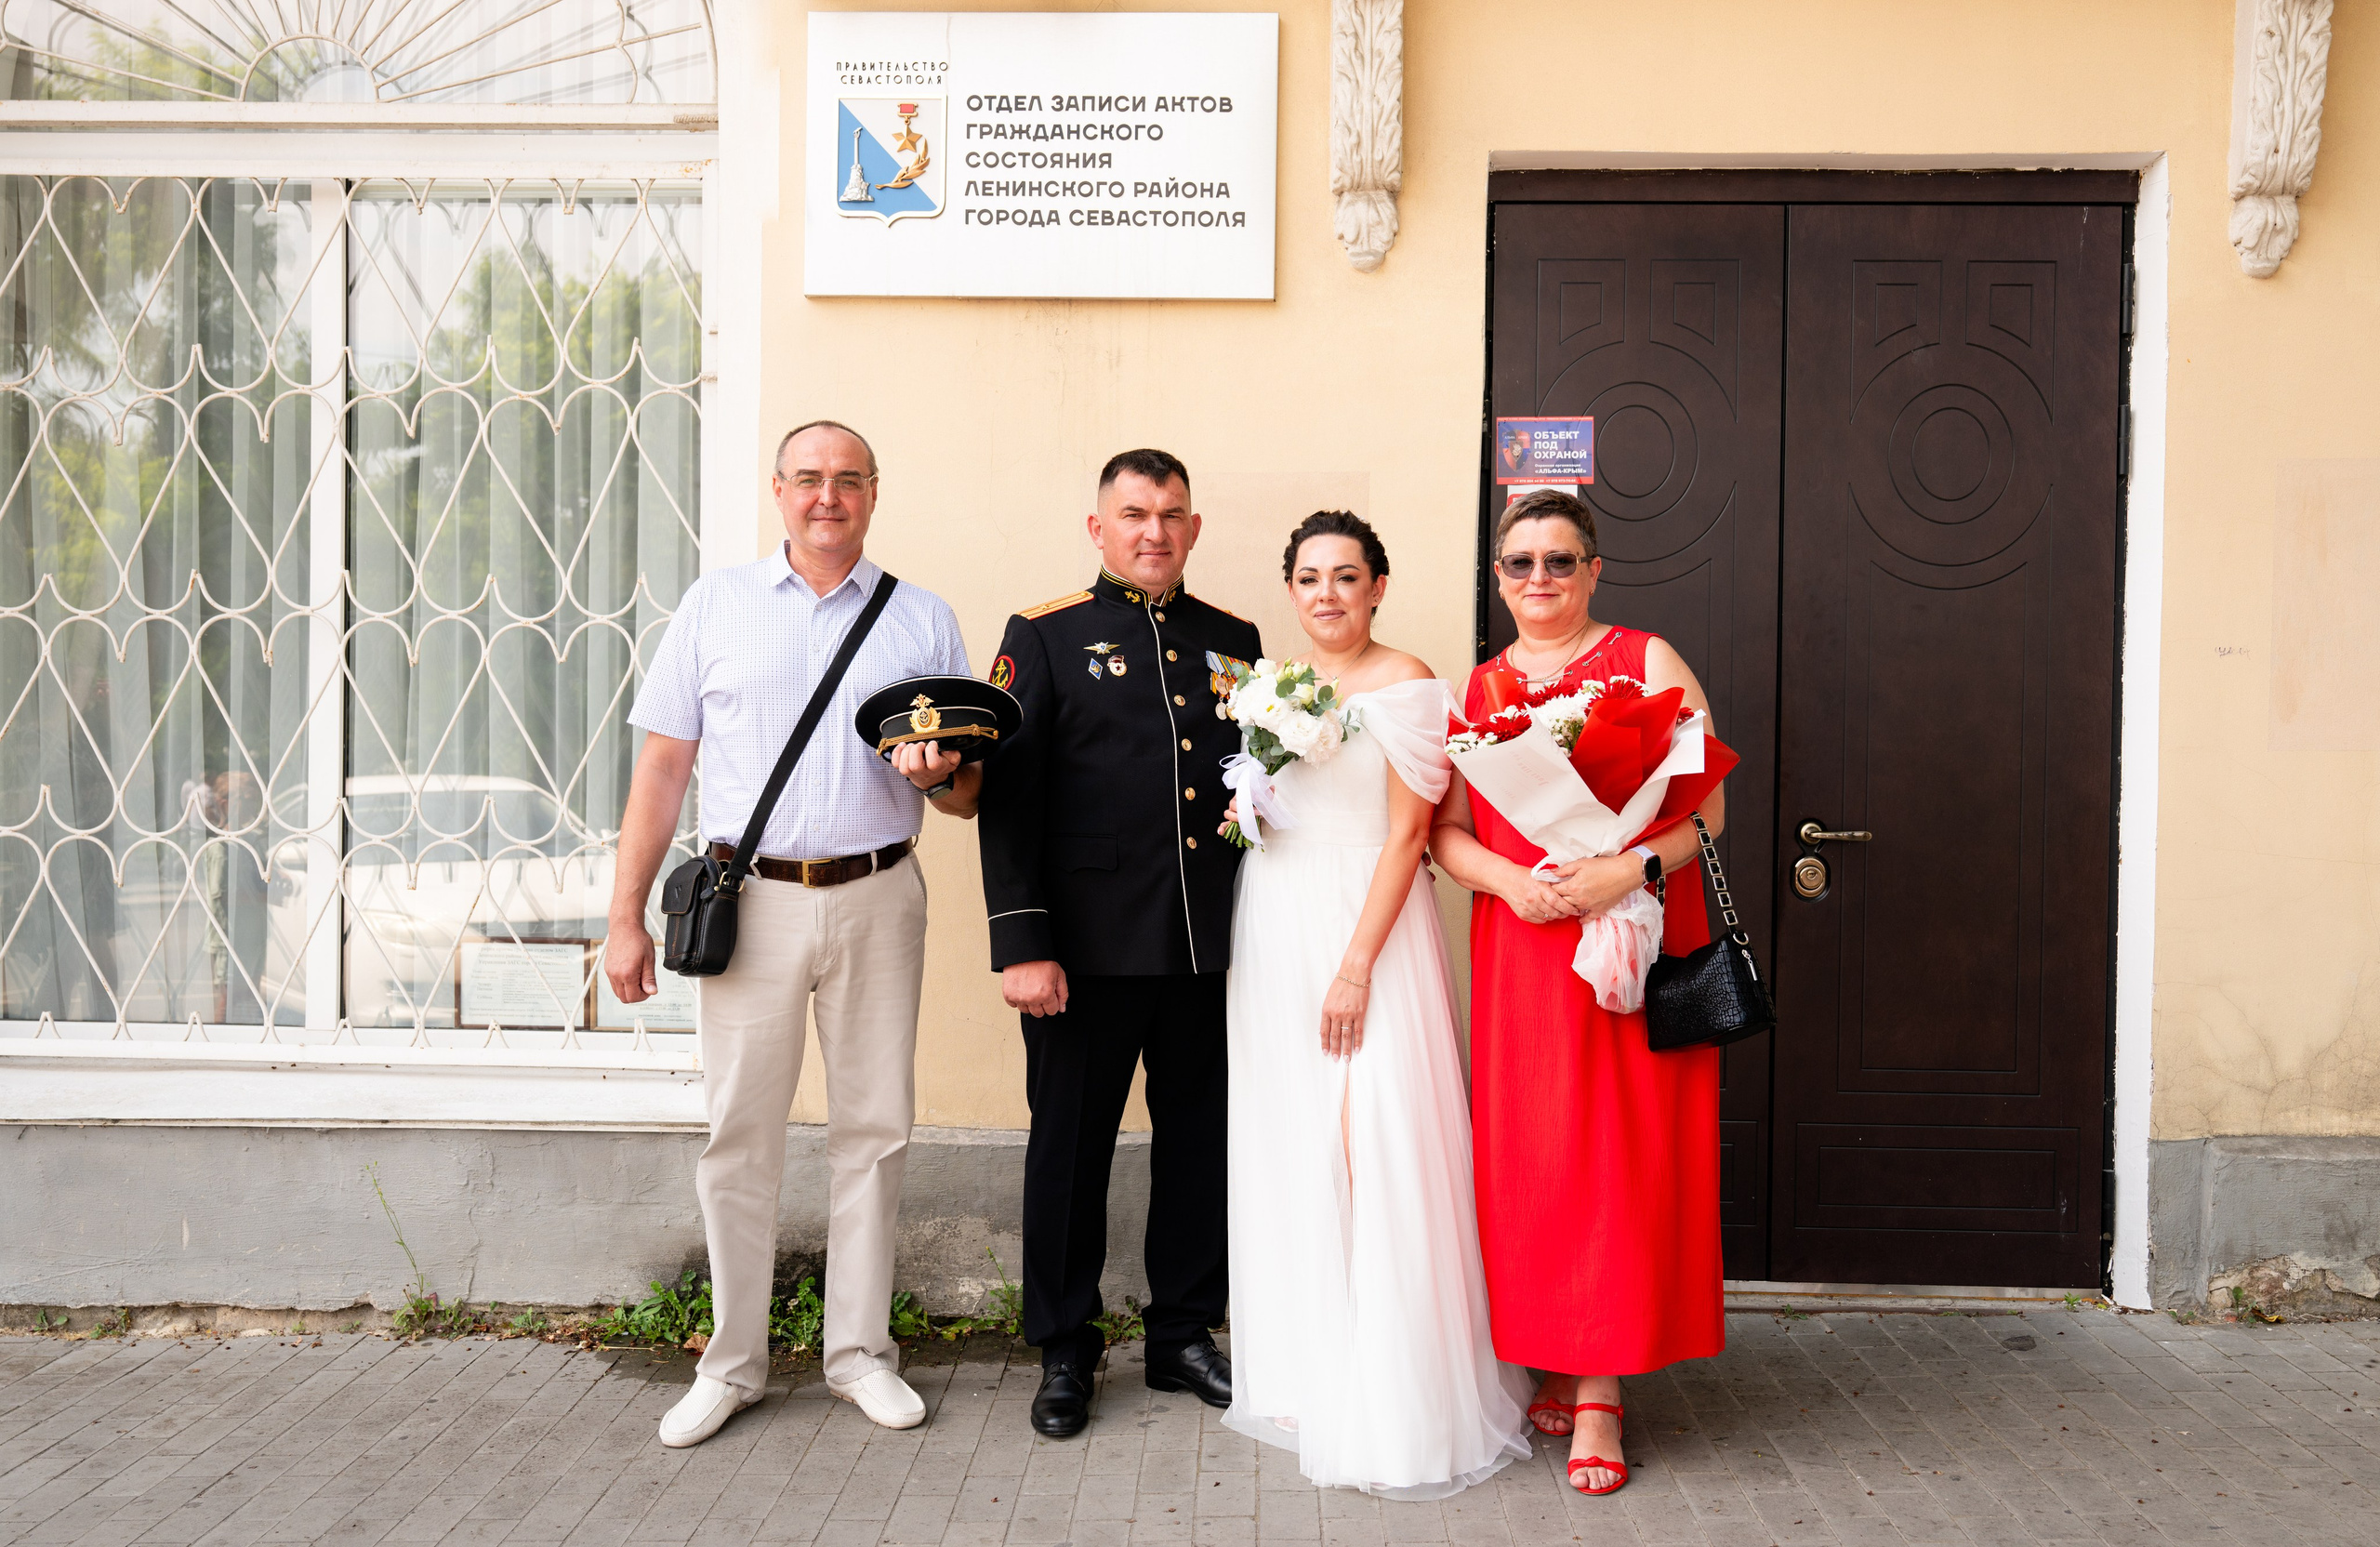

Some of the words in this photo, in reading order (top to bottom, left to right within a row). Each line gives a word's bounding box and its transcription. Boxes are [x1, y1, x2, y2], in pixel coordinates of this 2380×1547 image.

[837, 62, 947, 71] ПРАВИТЕЛЬСТВО
[841, 75, 941, 84] СЕВАСТОПОЛЯ
[967, 95, 1042, 112] ОТДЕЛ
[1051, 96, 1145, 112] ЗАПИСИ
[1155, 97, 1232, 112] АКТОВ
[967, 124, 1163, 141] ГРАЖДАНСКОГО
[966, 152, 1111, 168] СОСТОЯНИЯ
[965, 181, 1124, 197] ЛЕНИНСКОГО
[1134, 178, 1230, 198] РАЙОНА
[966, 209, 1060, 227] ГОРОДА
[1069, 210, 1245, 227] СЕВАСТОПОЛЯ
[1534, 431, 1580, 440] ОБЪЕКТ
[1534, 442, 1558, 450] ПОД
[1534, 449, 1587, 459] ОХРАНОЙ
